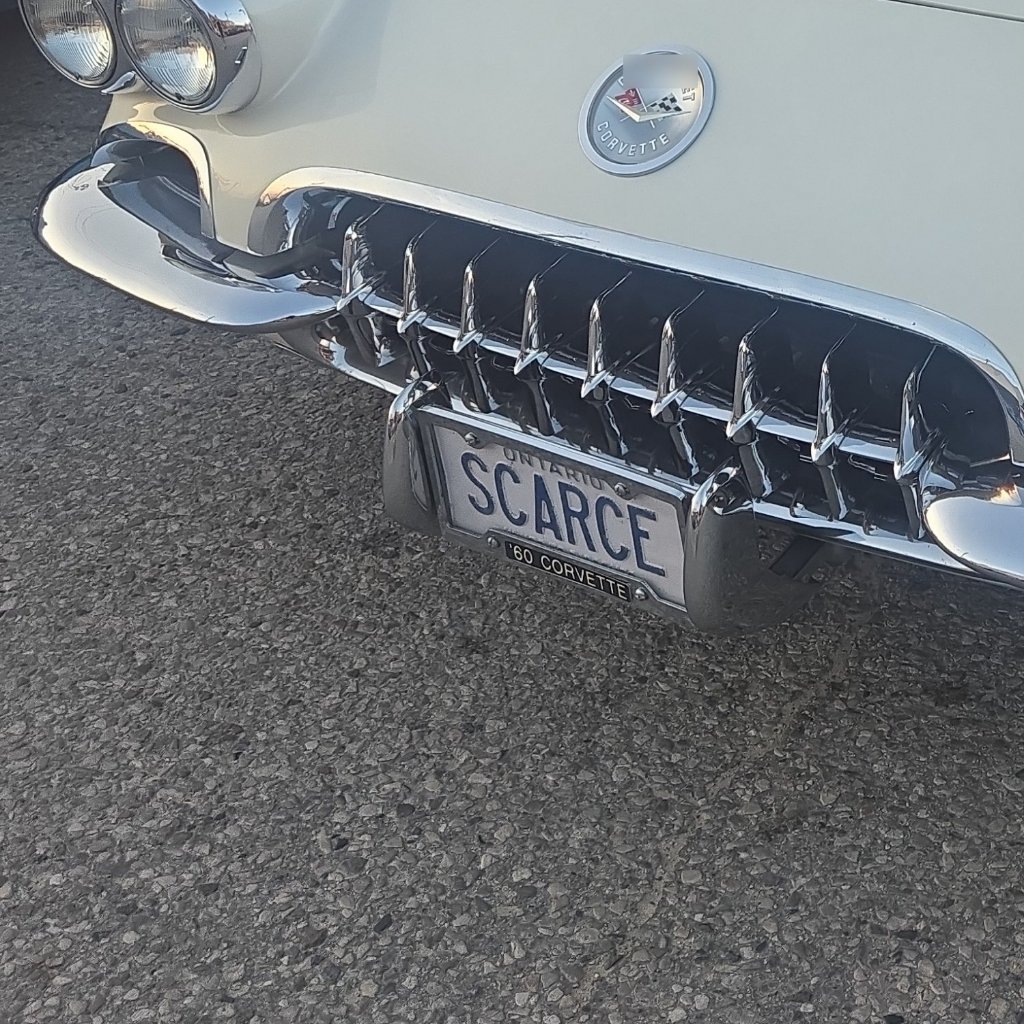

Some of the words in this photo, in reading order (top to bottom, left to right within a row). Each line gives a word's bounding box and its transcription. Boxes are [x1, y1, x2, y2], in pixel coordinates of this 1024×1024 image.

[597, 121, 670, 156] CORVETTE
[461, 452, 666, 577] SCARCE
[541, 554, 628, 600] CORVETTE
